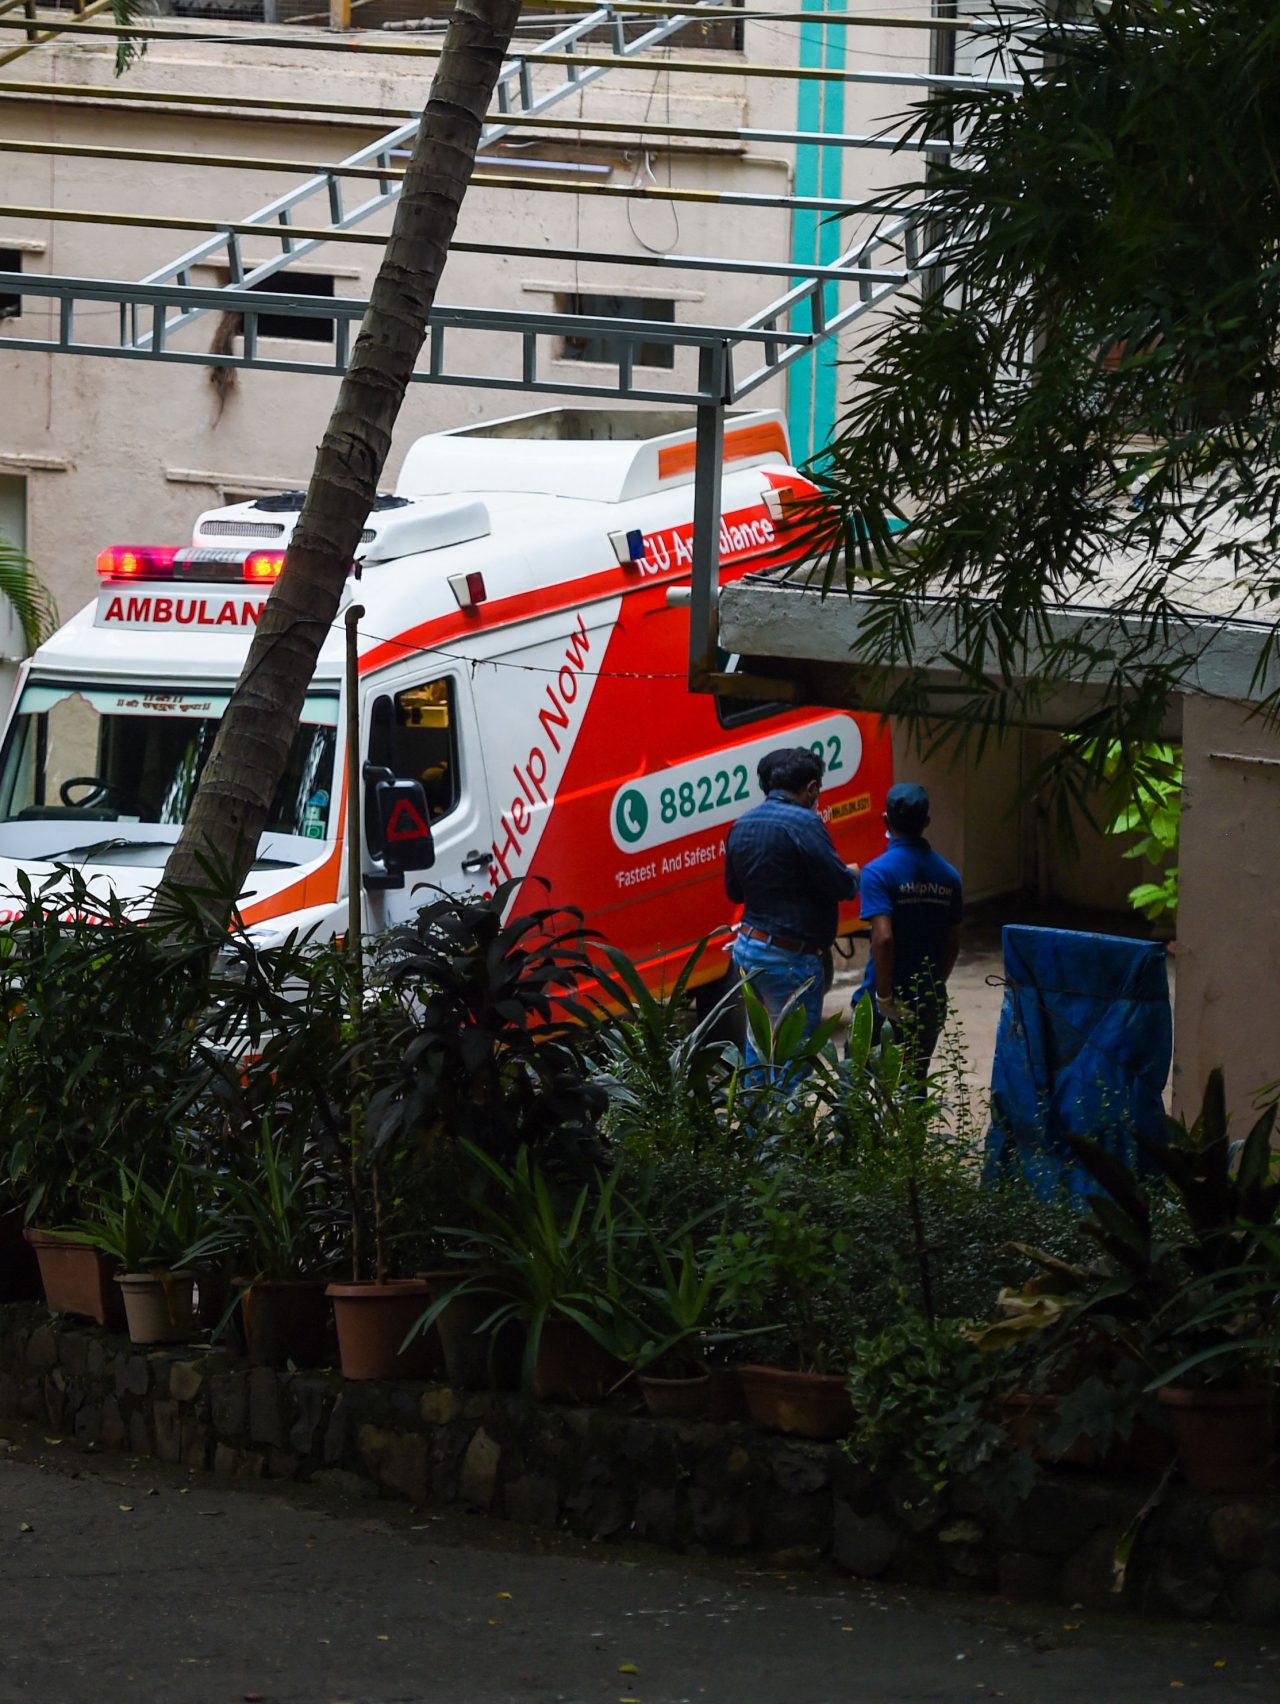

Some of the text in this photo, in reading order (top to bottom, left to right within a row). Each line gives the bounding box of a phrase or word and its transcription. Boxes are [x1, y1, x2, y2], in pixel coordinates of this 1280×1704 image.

[672, 517, 776, 567] Alance
[104, 596, 265, 626] AMBULAN
[660, 764, 750, 824] 88222
[661, 852, 682, 874] And
[684, 844, 716, 868] Safest
